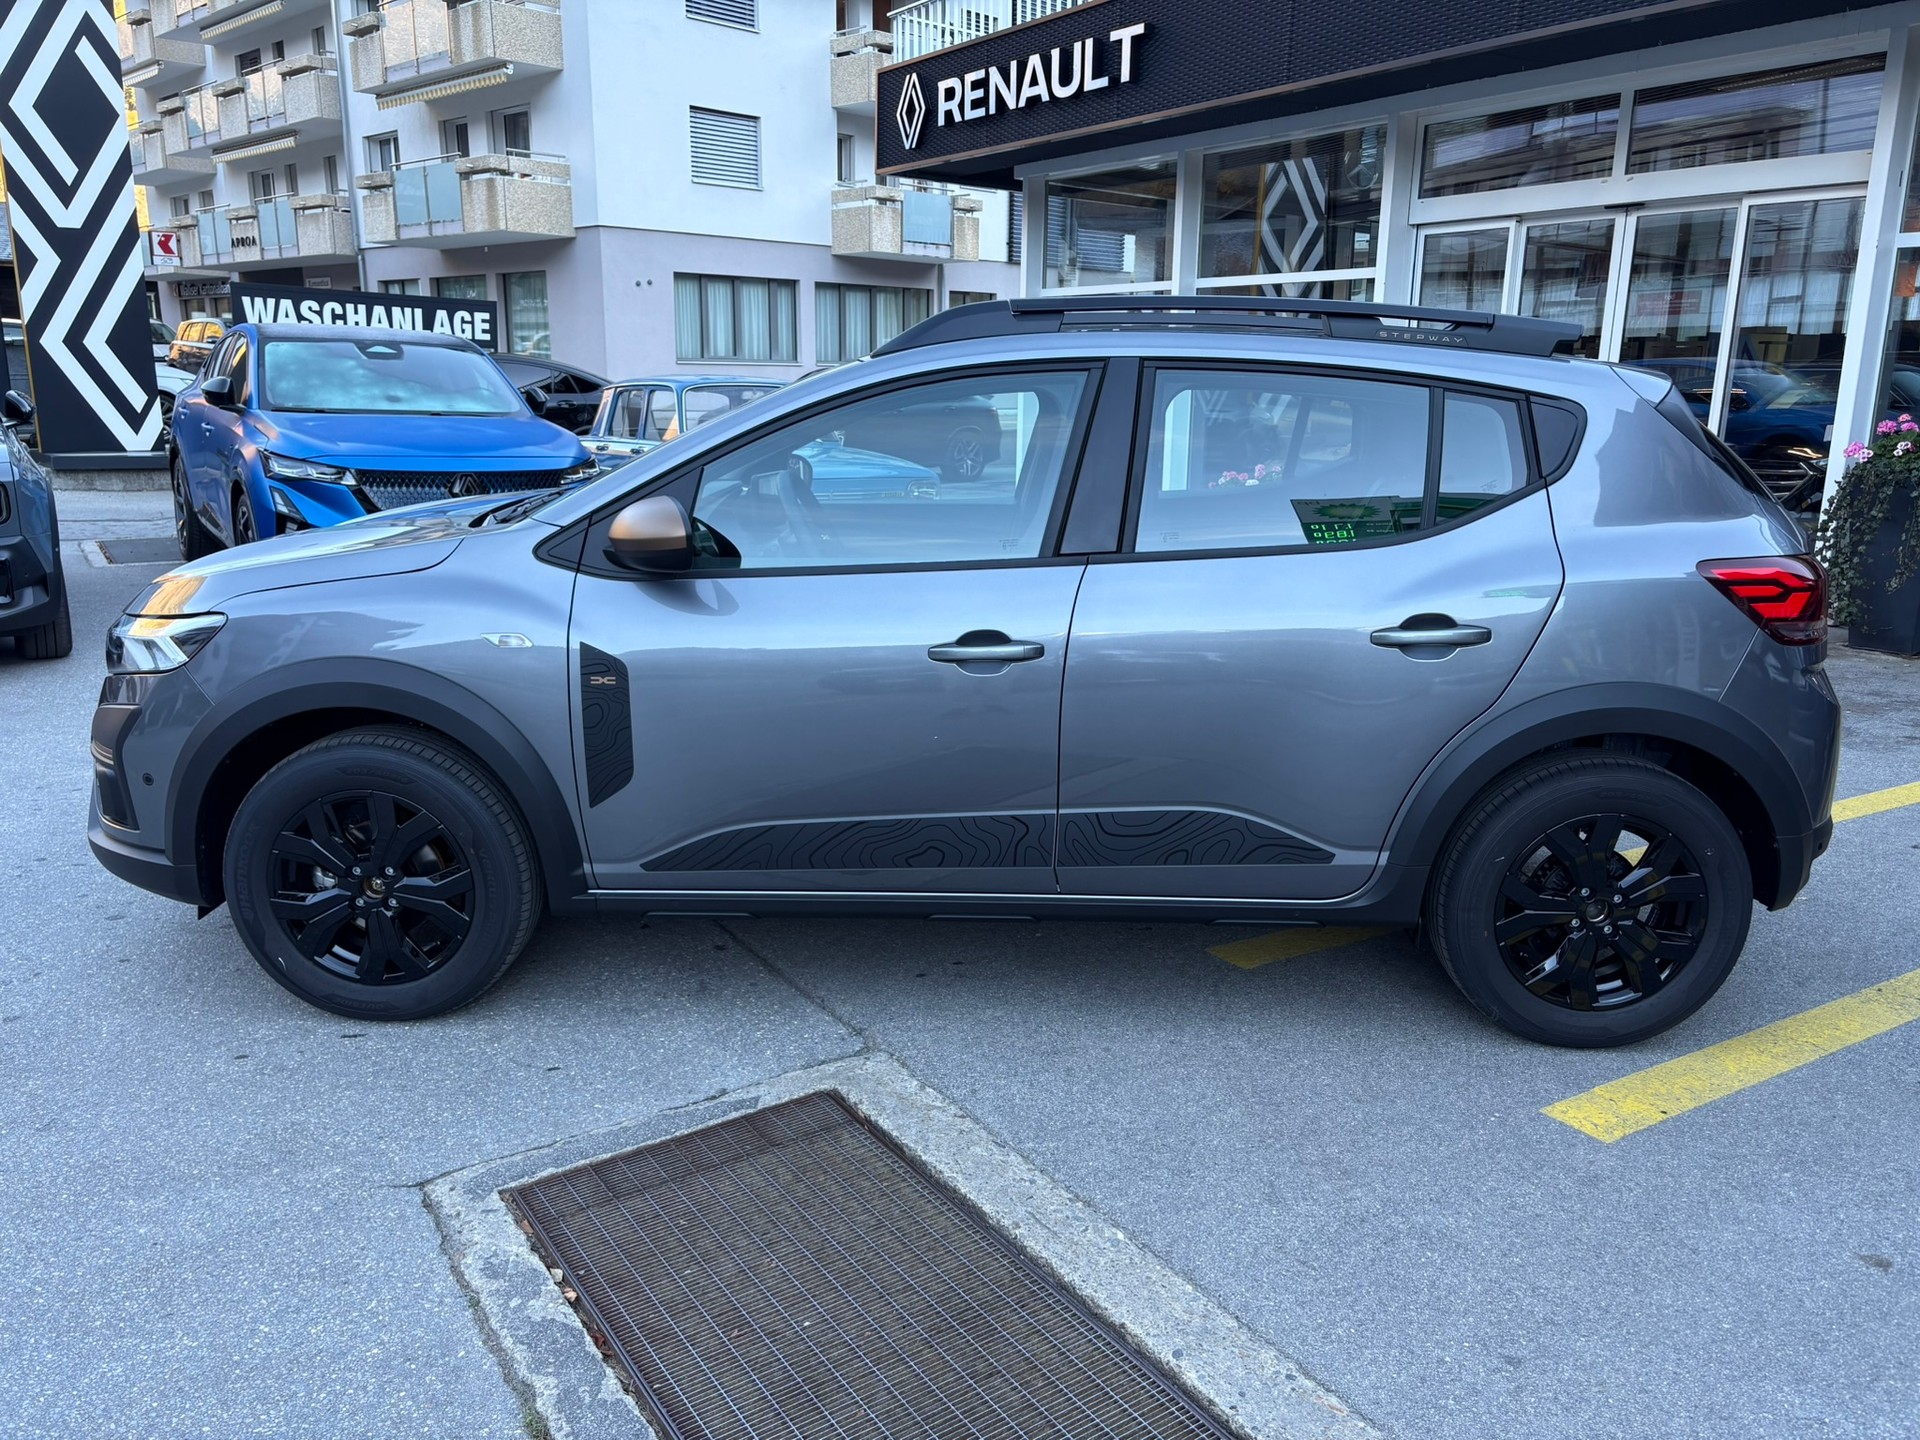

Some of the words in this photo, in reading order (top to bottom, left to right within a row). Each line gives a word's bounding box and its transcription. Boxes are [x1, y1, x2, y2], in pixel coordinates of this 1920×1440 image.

[938, 22, 1145, 127] RENAULT
[241, 295, 491, 341] WASCHANLAGE
[1379, 331, 1463, 343] STEPWAY
